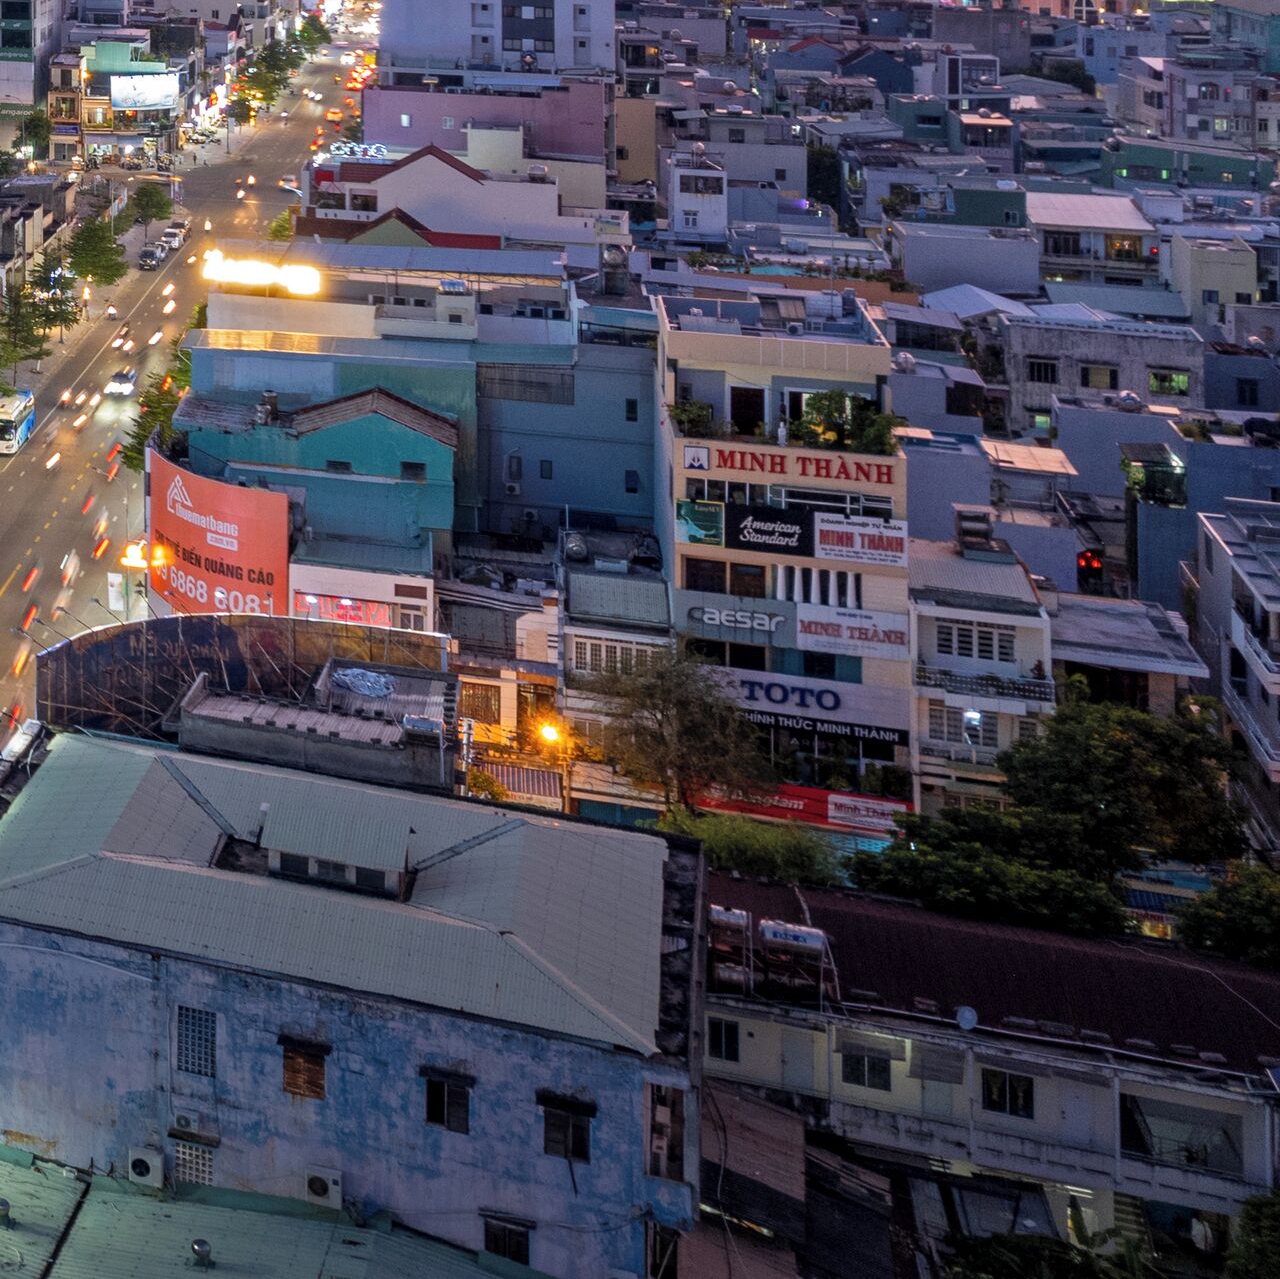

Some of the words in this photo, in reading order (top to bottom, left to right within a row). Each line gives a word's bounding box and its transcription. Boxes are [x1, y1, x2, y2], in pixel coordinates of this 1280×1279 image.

[716, 449, 787, 475] MINH
[796, 455, 895, 485] THÀNH
[739, 529, 800, 547] Standard
[740, 515, 802, 534] American
[819, 529, 855, 548] MINH
[859, 531, 905, 554] THÀNH
[170, 566, 208, 603] 6868
[799, 619, 843, 638] MINH
[847, 624, 906, 646] THÀNH
[740, 679, 842, 711] TOTO
[778, 715, 814, 731] THỨC
[816, 722, 851, 736] MINH
[854, 725, 899, 742] THÀNH
